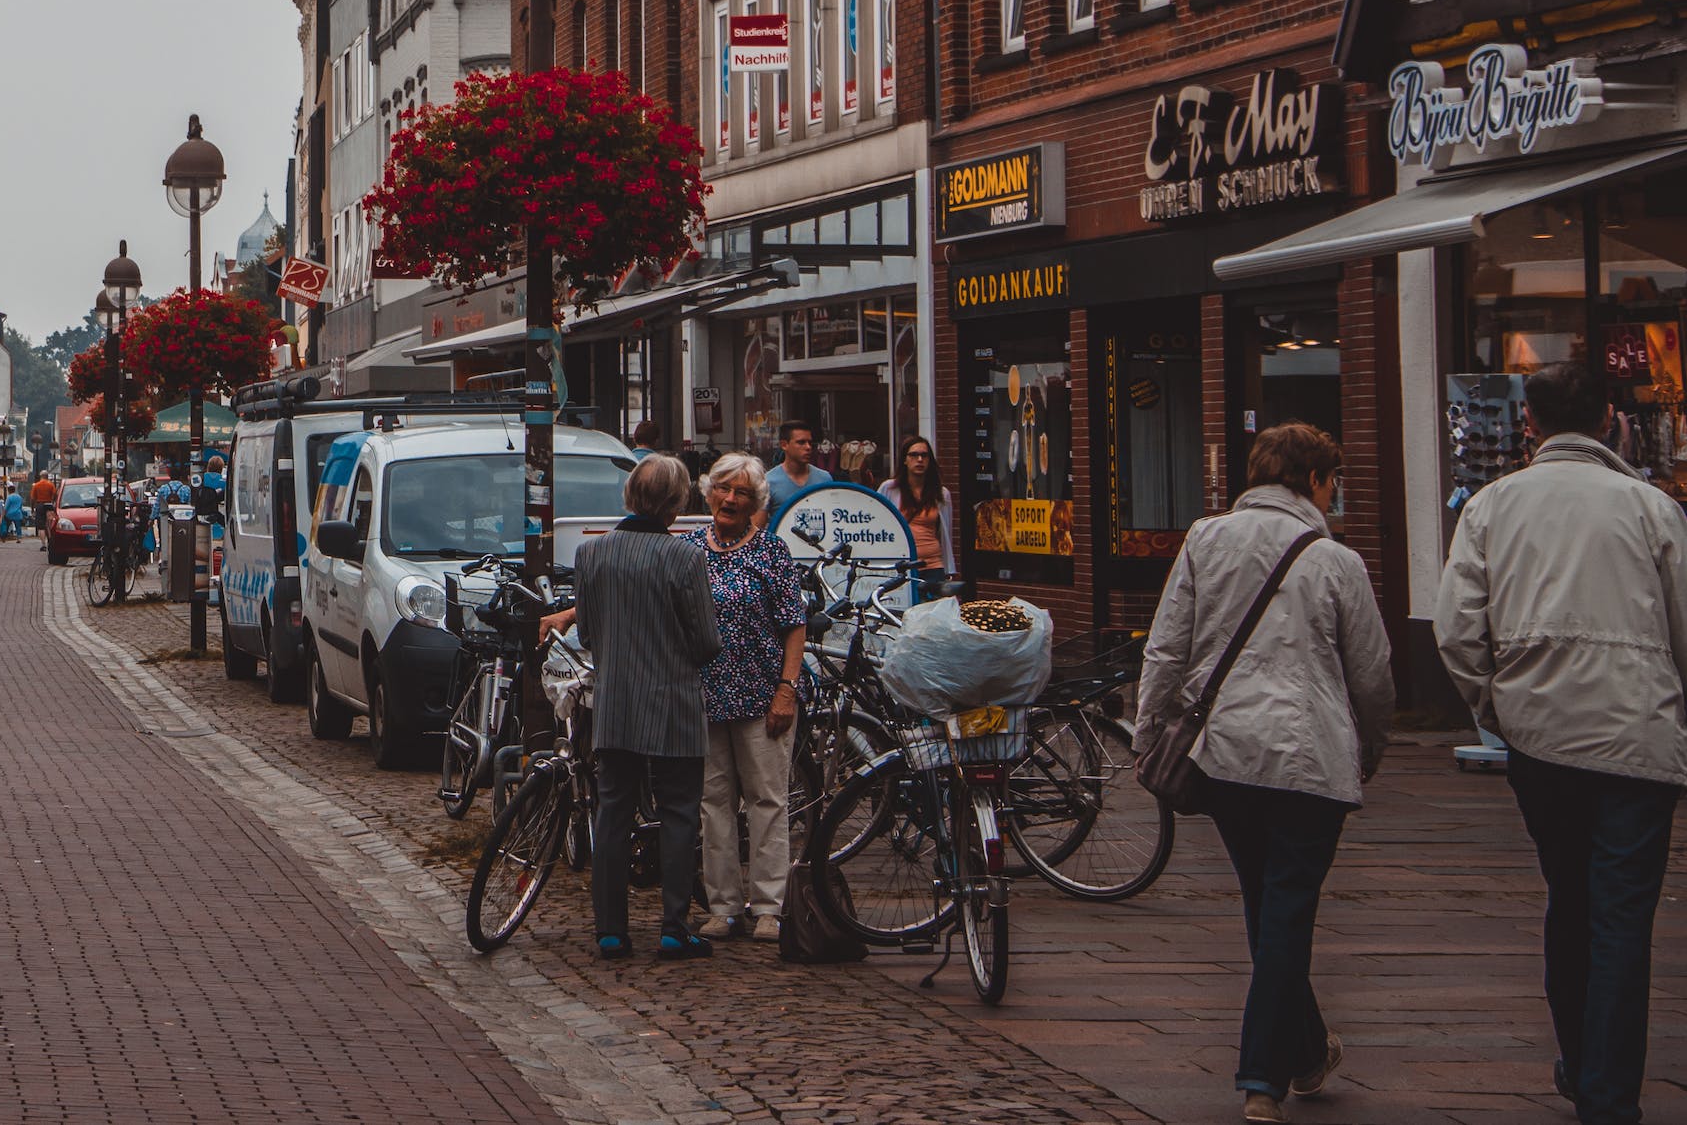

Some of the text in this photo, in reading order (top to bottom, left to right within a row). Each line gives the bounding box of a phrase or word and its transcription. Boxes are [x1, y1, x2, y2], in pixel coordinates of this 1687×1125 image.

[1224, 69, 1320, 166] May
[1389, 48, 1580, 164] Bijou Brigitte
[1217, 155, 1321, 211] SCHMUCK
[990, 201, 1028, 225] NIENBURG
[958, 263, 1063, 306] GOLDANKAUF
[832, 508, 876, 524] Rats-
[1015, 507, 1046, 523] SOFORT
[833, 528, 895, 545] Apotheke
[1015, 530, 1047, 547] BARGELD
